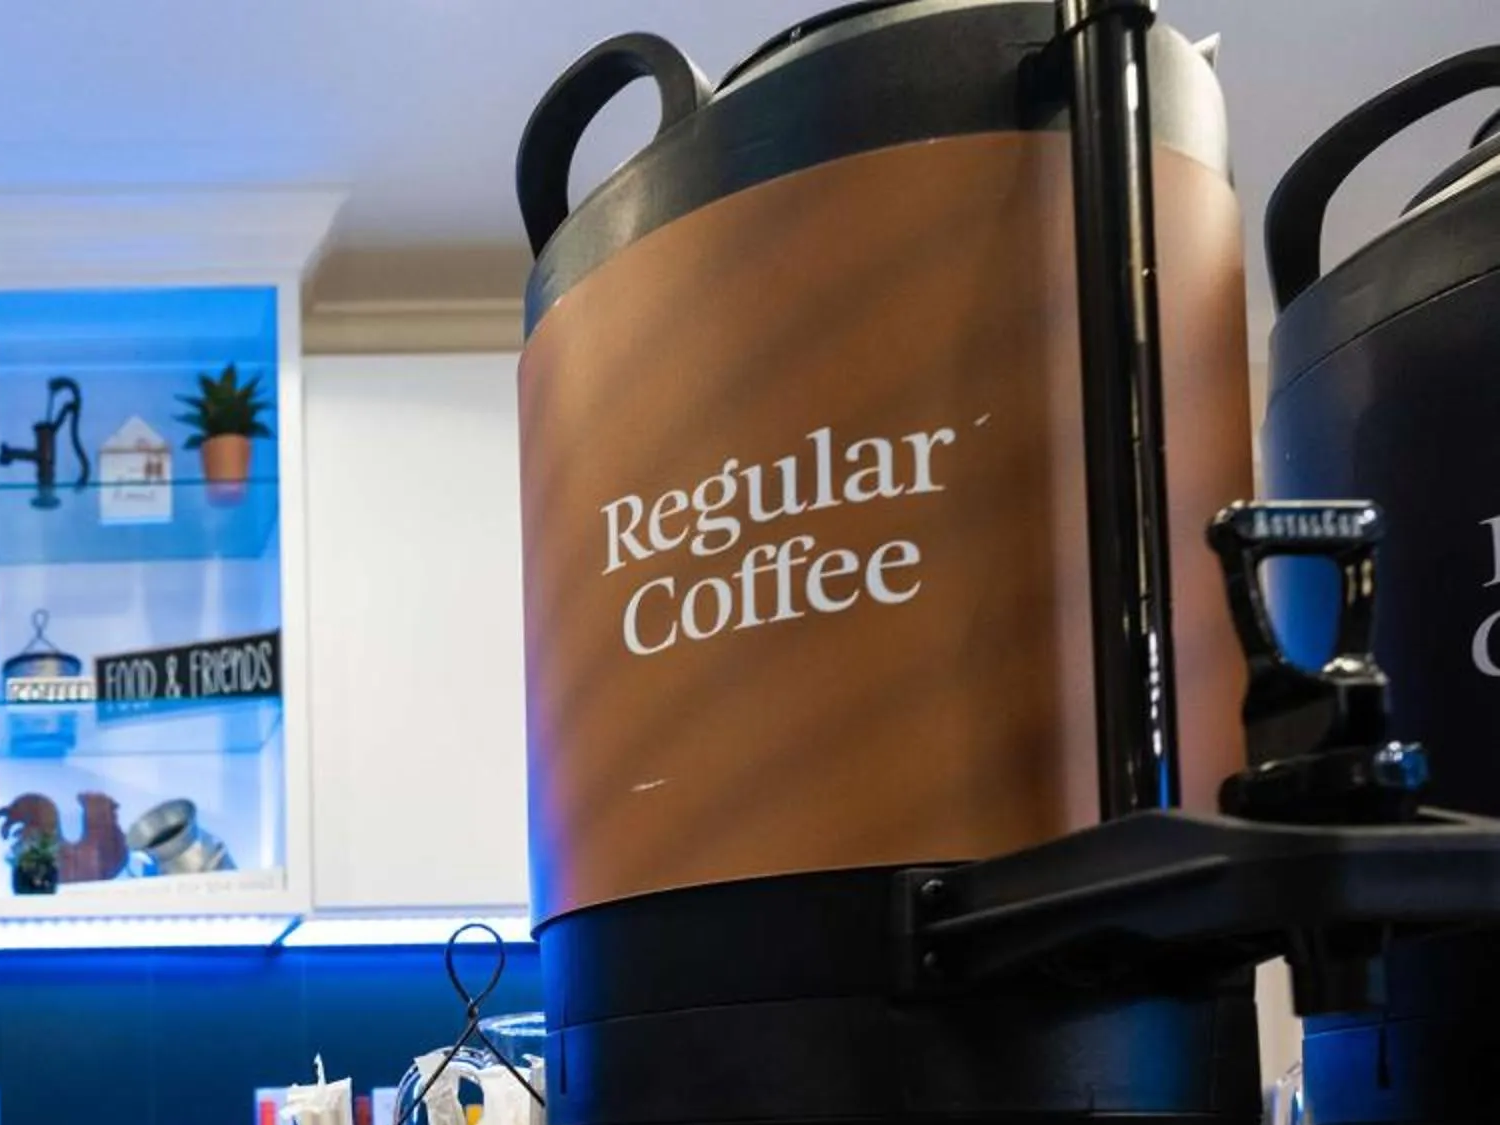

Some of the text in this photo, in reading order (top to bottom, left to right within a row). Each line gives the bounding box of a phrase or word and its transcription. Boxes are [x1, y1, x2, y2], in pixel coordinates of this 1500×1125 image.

[601, 426, 956, 576] Regular
[623, 535, 921, 655] Coffee
[105, 660, 157, 711] FOOD
